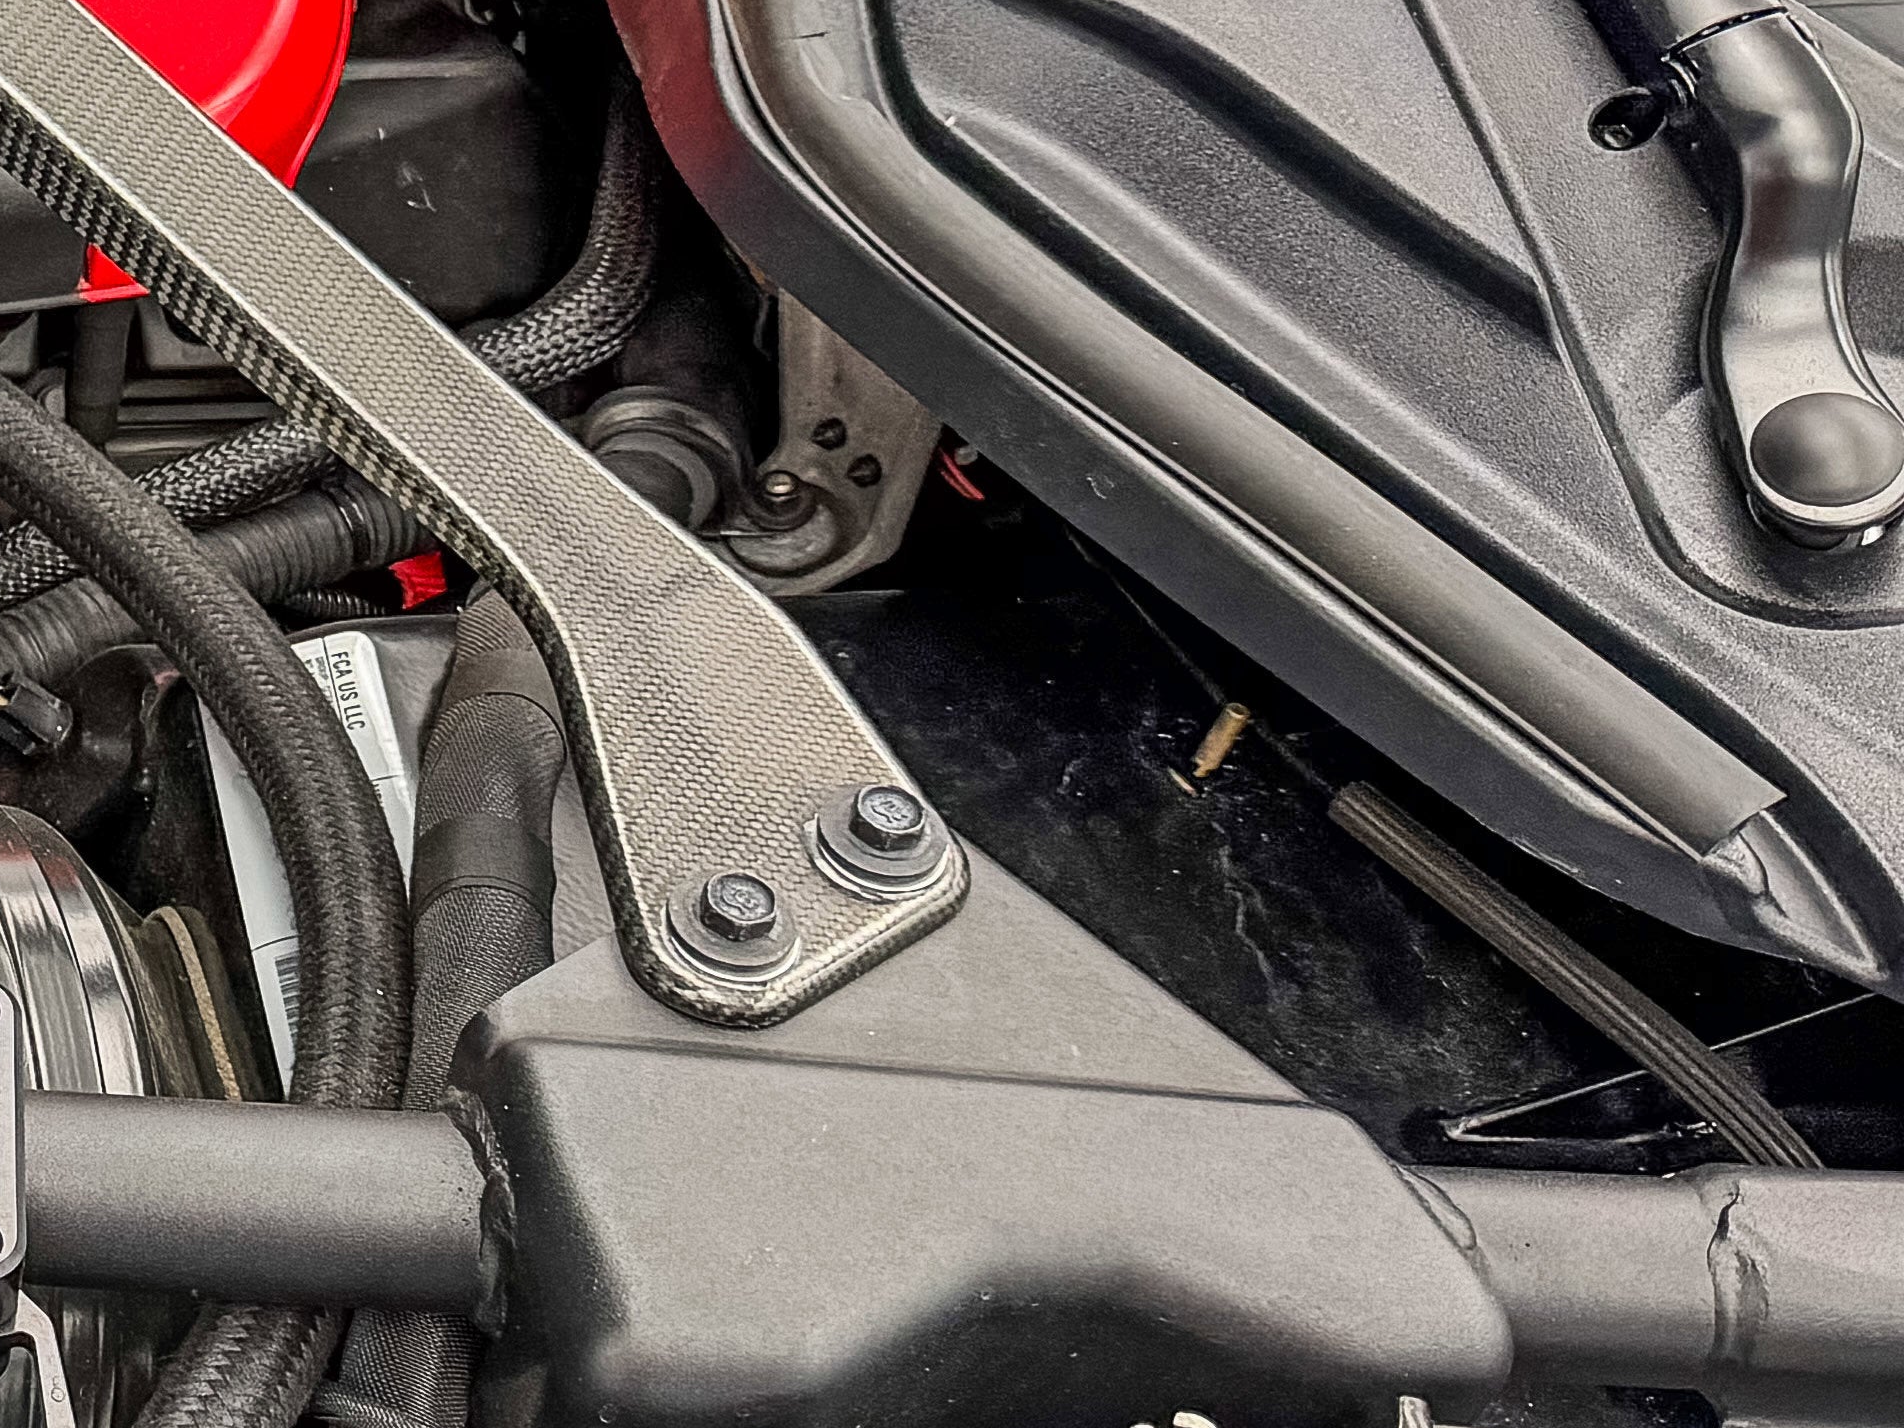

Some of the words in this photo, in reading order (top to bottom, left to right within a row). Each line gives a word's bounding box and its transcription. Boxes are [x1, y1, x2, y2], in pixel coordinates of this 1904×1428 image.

[330, 650, 354, 680] FCA
[337, 680, 360, 702] US
[343, 704, 367, 731] LLC
